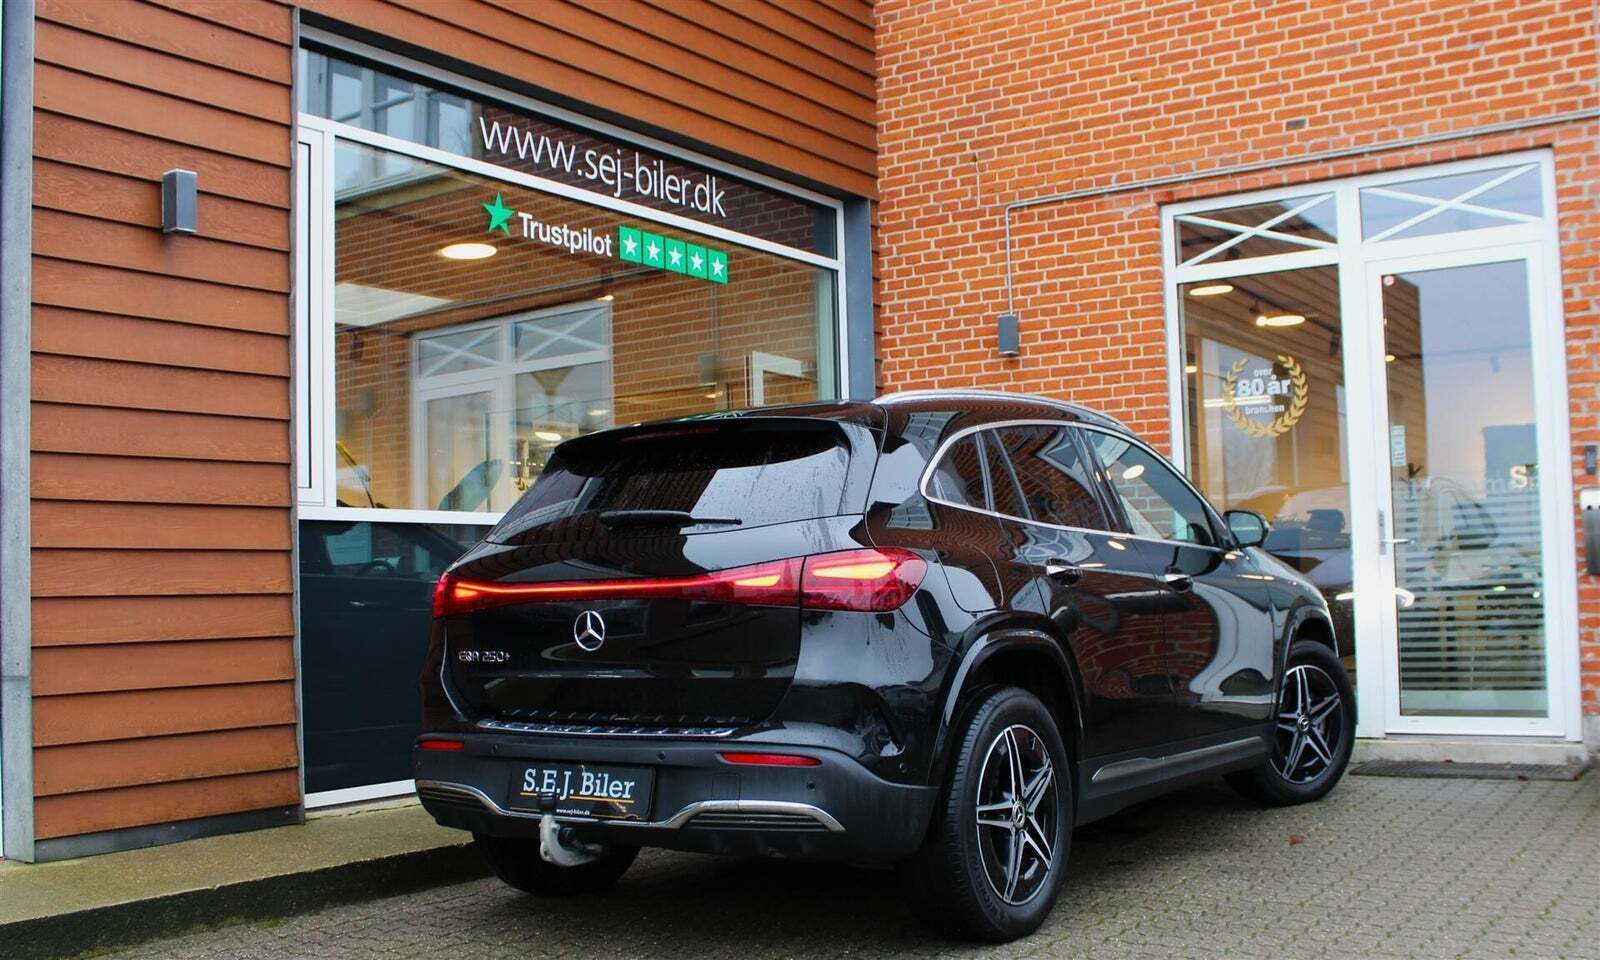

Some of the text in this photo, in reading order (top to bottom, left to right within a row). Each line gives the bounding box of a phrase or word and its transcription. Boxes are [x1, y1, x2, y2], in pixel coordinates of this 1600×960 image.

[479, 116, 726, 217] www.sej-biler.dk
[518, 211, 612, 256] Trustpilot
[1236, 375, 1291, 396] 80 år
[523, 768, 635, 800] S.E.J. Biler
